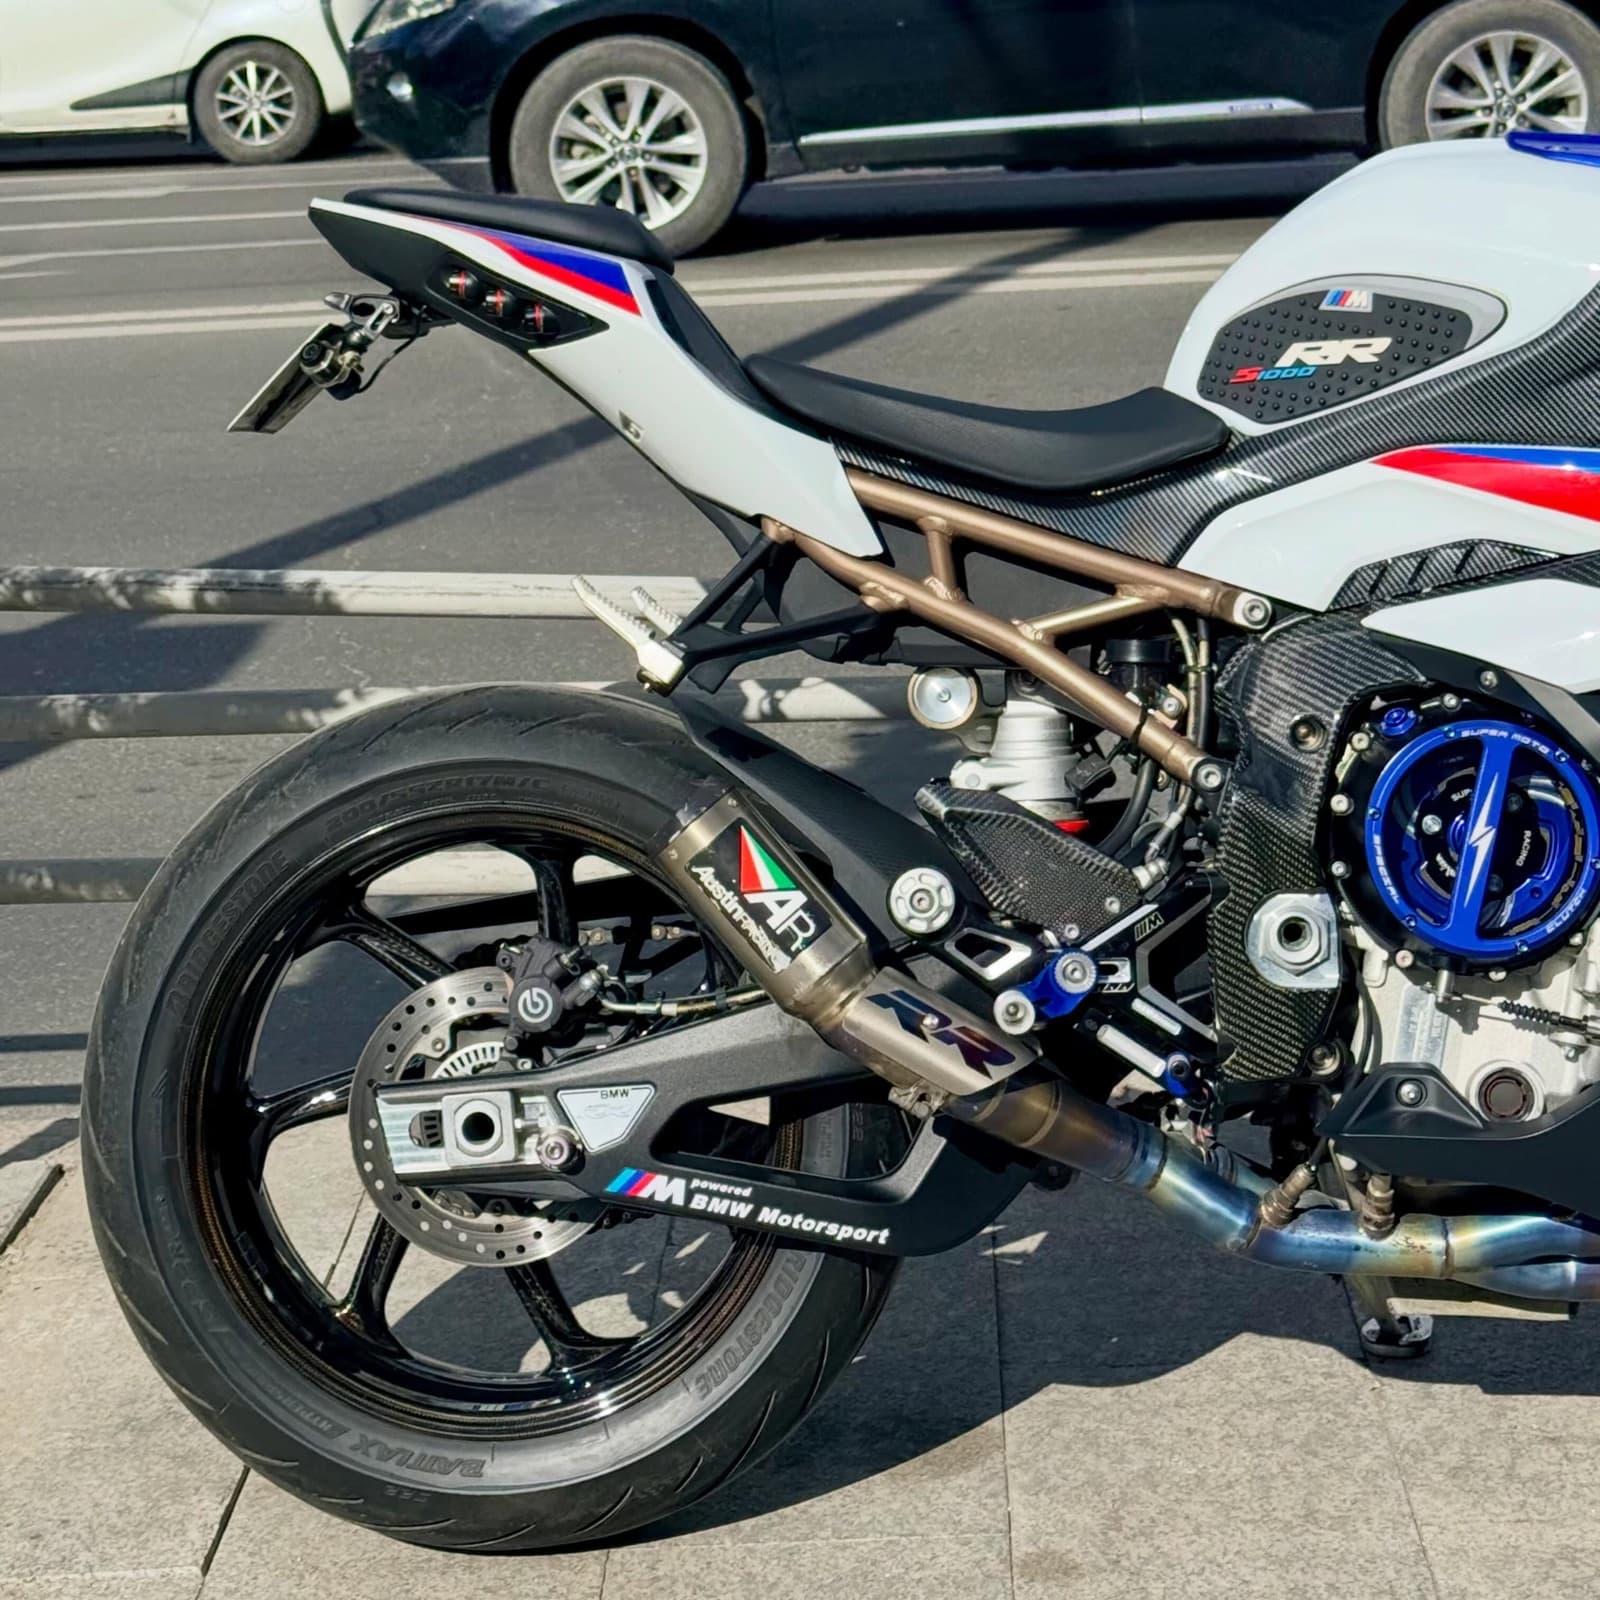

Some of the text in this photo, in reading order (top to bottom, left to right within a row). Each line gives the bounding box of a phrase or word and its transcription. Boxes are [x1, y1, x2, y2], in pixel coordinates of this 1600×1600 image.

[1275, 336, 1392, 367] RR
[1230, 365, 1316, 384] S1000
[1461, 728, 1551, 755] SUPER MOTO
[1515, 830, 1532, 867] RACING
[1373, 834, 1400, 905] SPECIAL
[743, 891, 816, 952] AR
[1545, 887, 1587, 935] CLUTCH
[600, 1088, 630, 1099] BMW
[690, 1178, 753, 1197] powered
[688, 1194, 891, 1245] BMW Motorsport
[695, 1253, 807, 1400] RIDGESTONE
